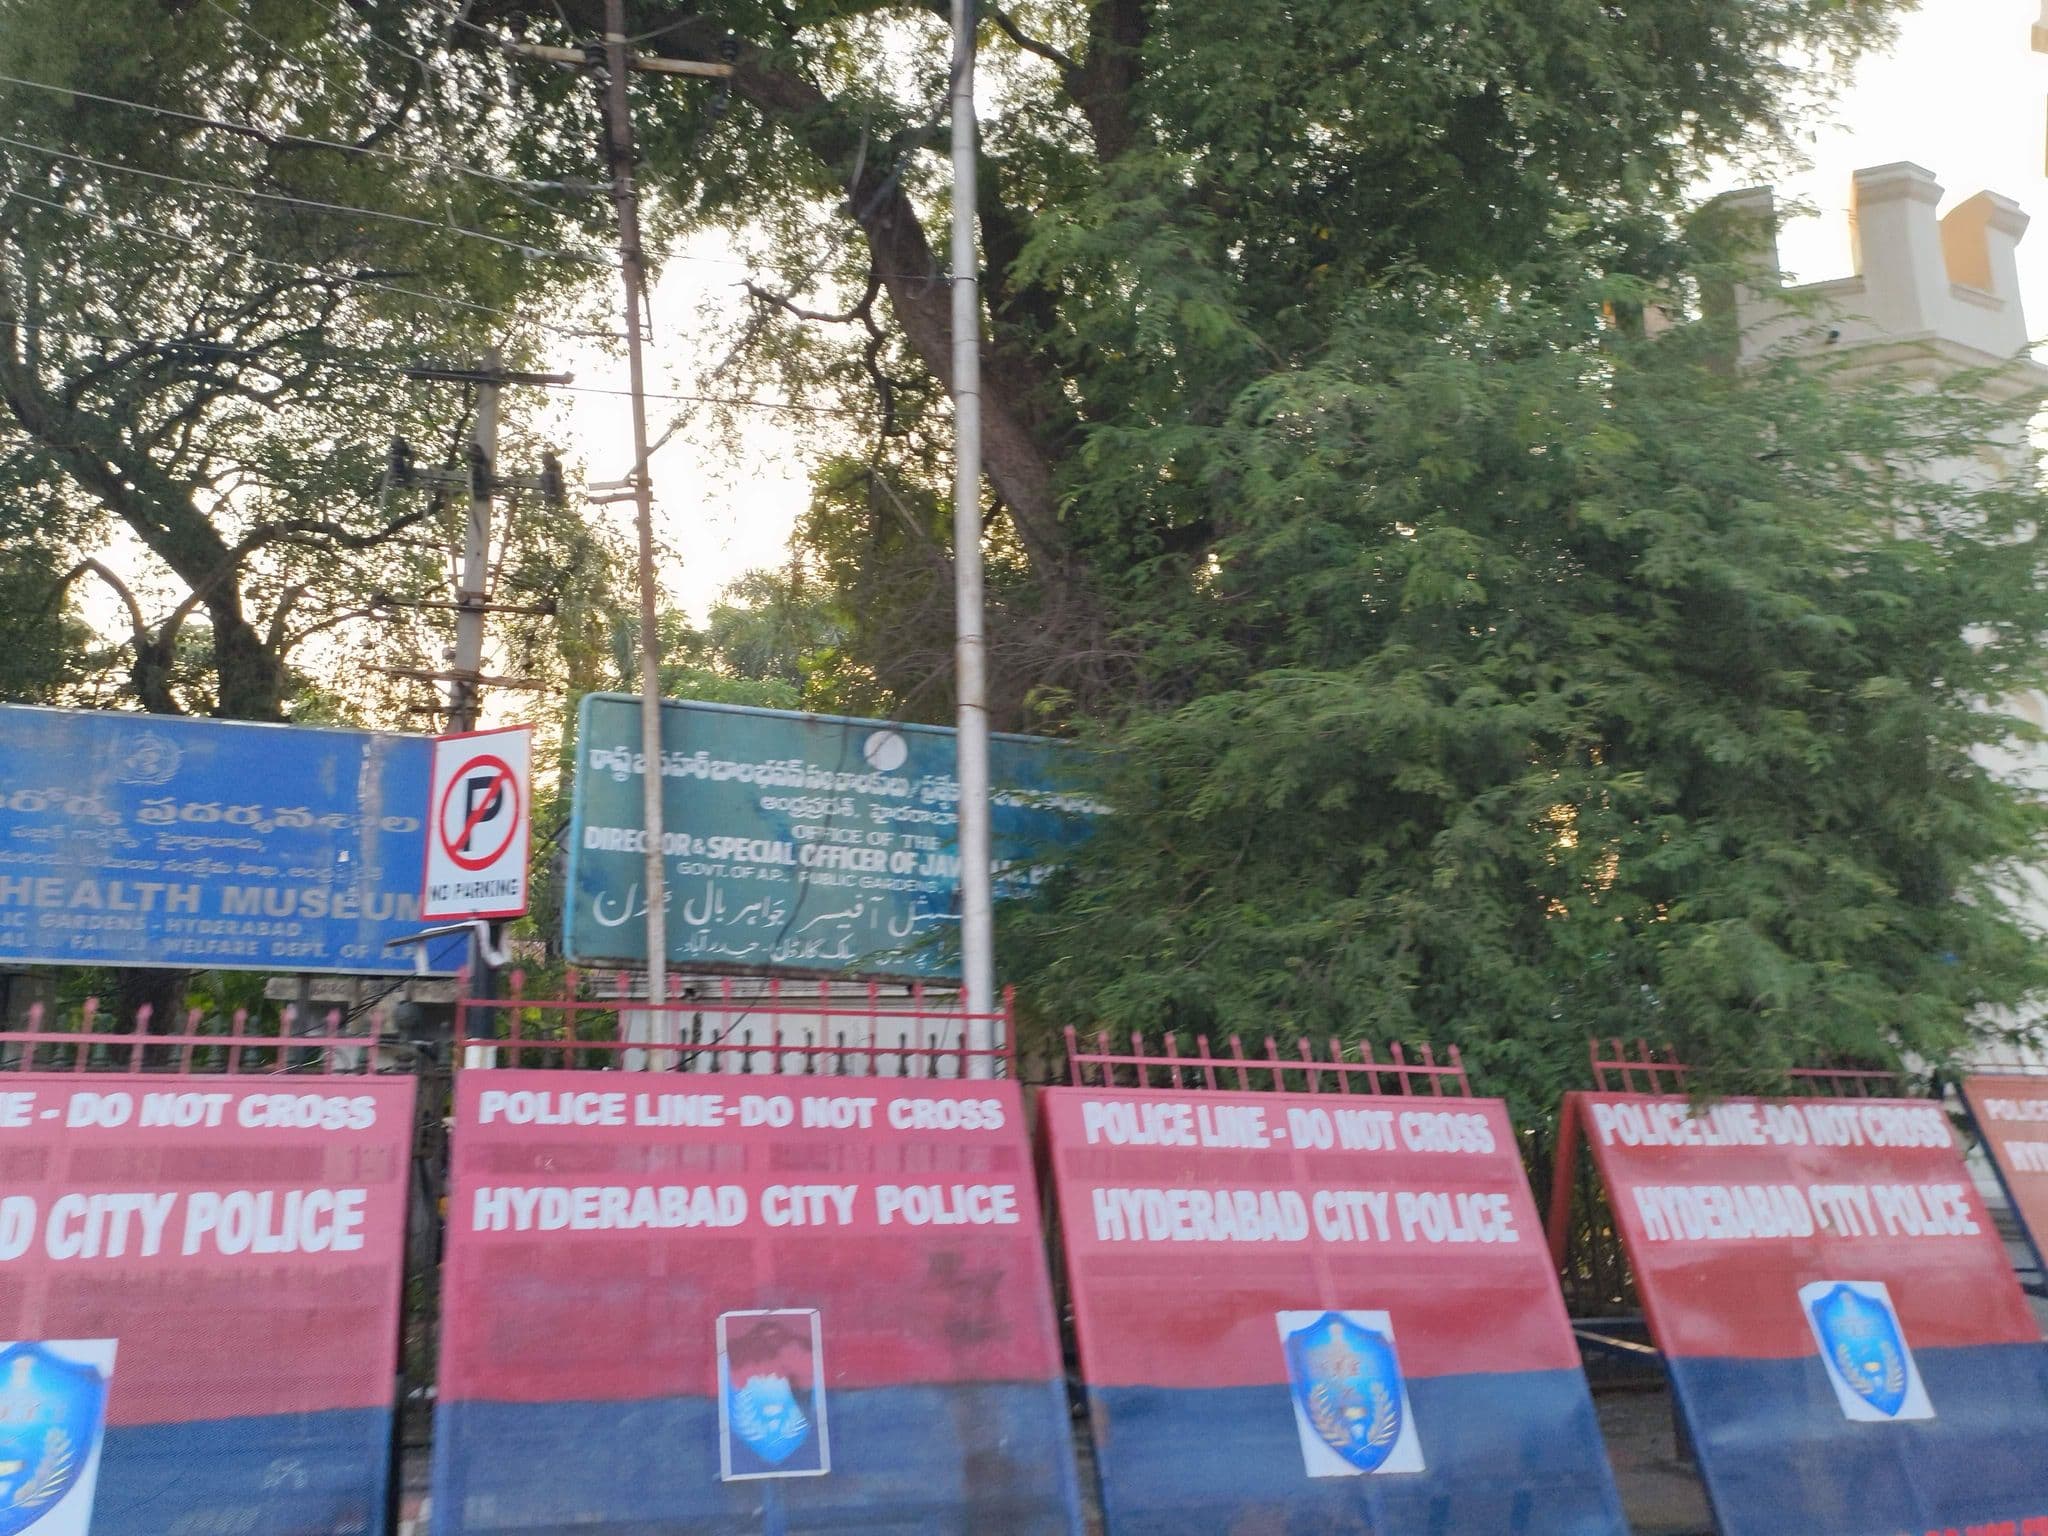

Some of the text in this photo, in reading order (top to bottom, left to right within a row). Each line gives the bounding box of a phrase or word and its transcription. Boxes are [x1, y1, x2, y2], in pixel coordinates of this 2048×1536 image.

[584, 826, 692, 857] DIRECOR
[706, 836, 797, 866] SPECIAL
[799, 843, 888, 873] OFFICER
[890, 850, 918, 875] OF
[791, 825, 941, 850] OFFICE OF THE
[0, 875, 422, 922] HEALTH MUSEUM
[431, 879, 518, 901] NO PARKING
[798, 871, 856, 887] PUBLIC
[340, 943, 369, 959] OF
[66, 1091, 134, 1128] DO
[138, 1092, 233, 1128] NOT
[236, 1094, 377, 1131] CROSS
[478, 1090, 627, 1127] POLICE
[801, 1096, 878, 1129] NOT
[887, 1098, 1006, 1131] CROSS
[1081, 1101, 1198, 1147] POLICE
[1196, 1104, 1271, 1149] LINE
[1286, 1107, 1334, 1150] DO
[1333, 1108, 1397, 1151] NOT
[1399, 1111, 1497, 1153] CROSS
[1591, 1102, 1703, 1147] POLICE
[1803, 1104, 1865, 1147] NOT
[1861, 1104, 1951, 1149] CROSS
[45, 1192, 179, 1261] CITY
[181, 1188, 368, 1256] POLICE
[472, 1183, 1021, 1232] HYDERABAD CITY POLICE
[1091, 1187, 1520, 1244] HYDERABAD CITY POLICE
[1631, 1184, 1814, 1241] HYDERABAD
[1870, 1183, 1981, 1237] POLICE
